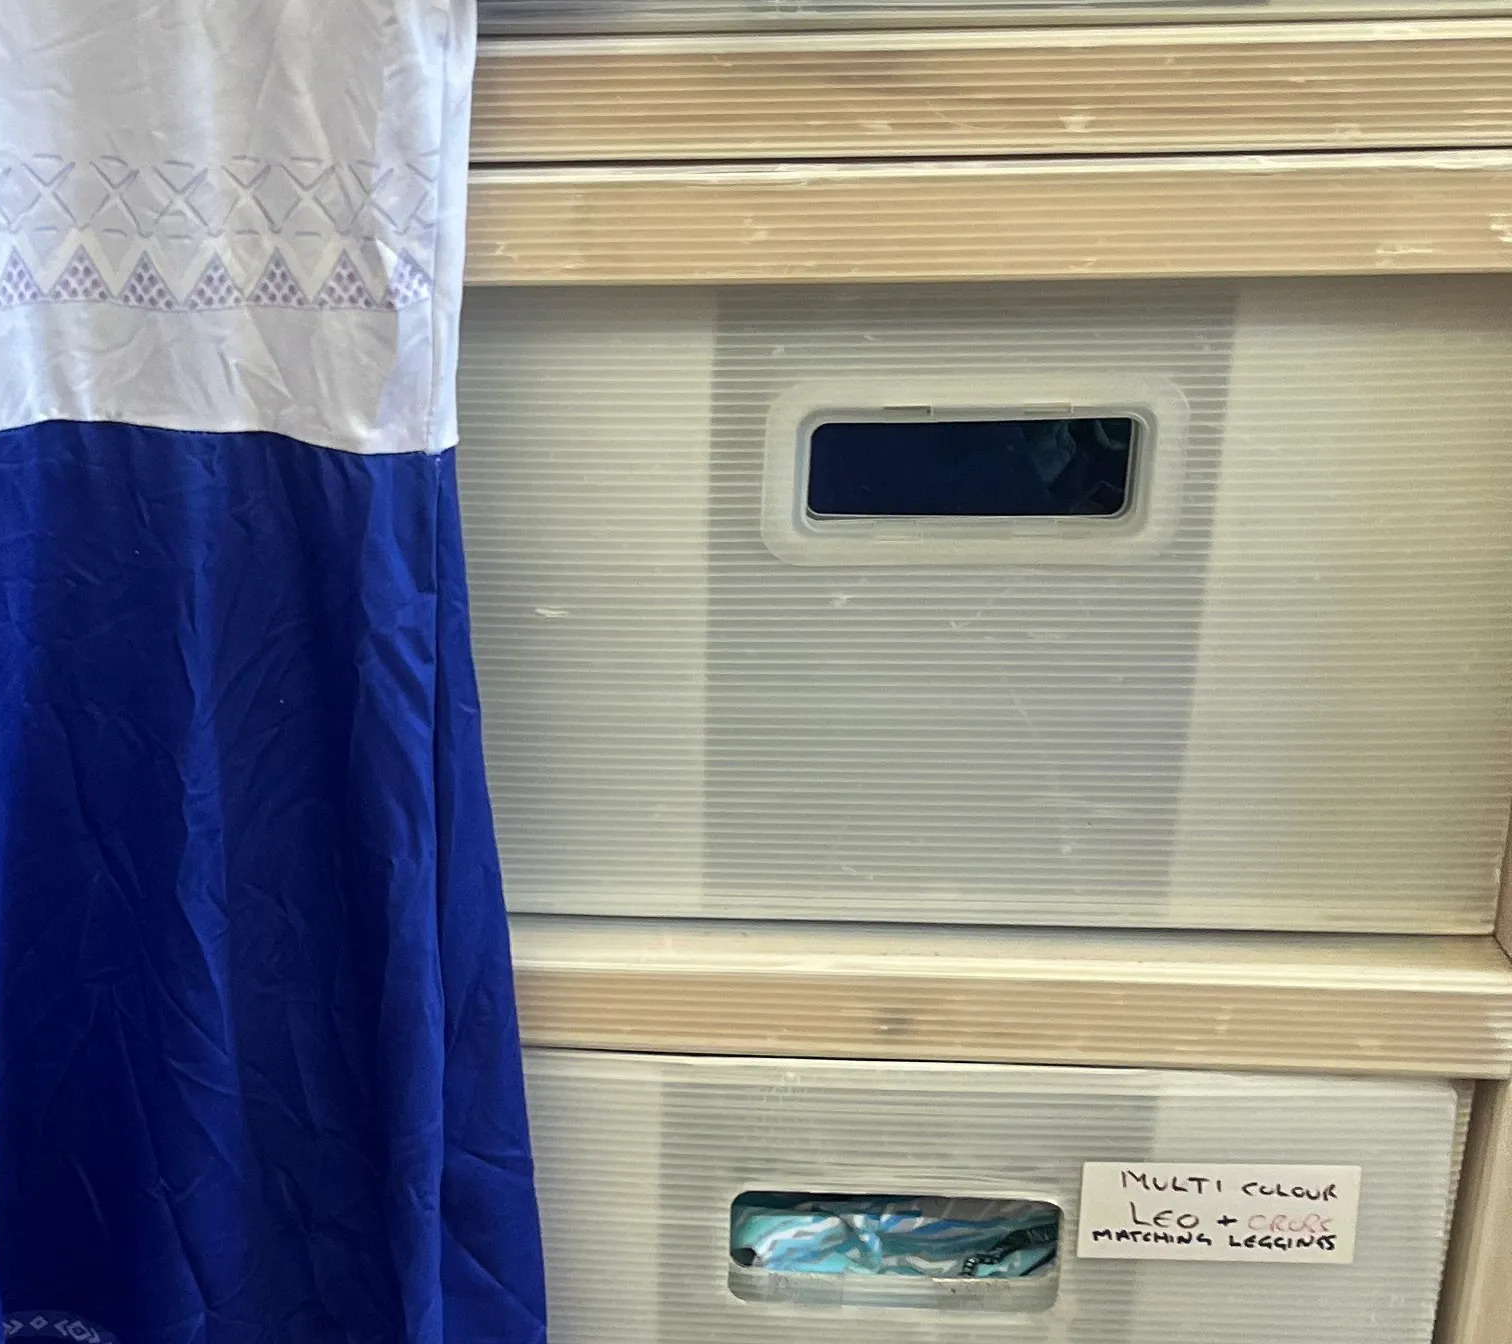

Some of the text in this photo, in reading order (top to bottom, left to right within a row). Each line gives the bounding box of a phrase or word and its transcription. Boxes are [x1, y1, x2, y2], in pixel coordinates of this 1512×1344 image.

[1120, 1169, 1338, 1202] MULTI COLOUR
[1129, 1202, 1200, 1230] LEO
[1092, 1229, 1212, 1246] MATCHING
